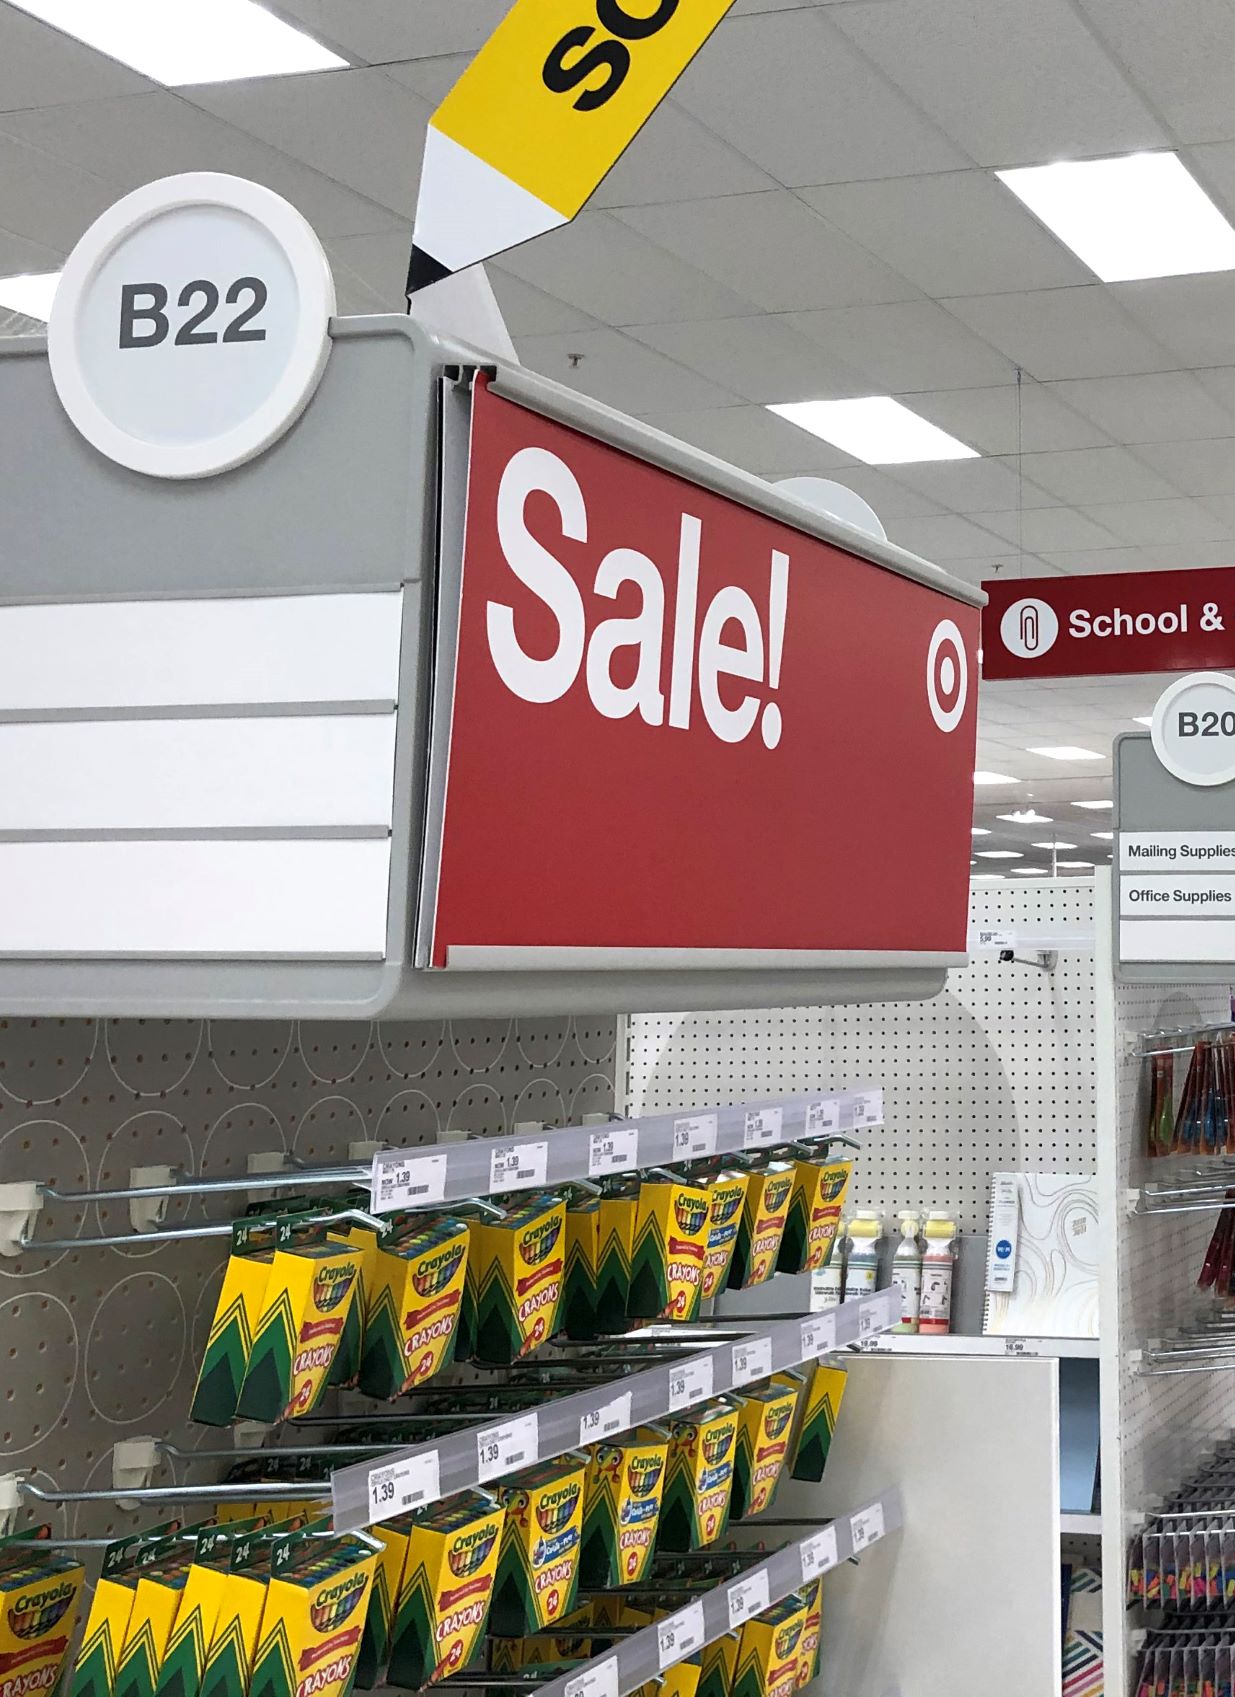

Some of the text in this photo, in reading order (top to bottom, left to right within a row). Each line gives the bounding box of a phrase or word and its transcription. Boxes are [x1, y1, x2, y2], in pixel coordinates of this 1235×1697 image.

[119, 276, 268, 349] B22
[486, 446, 790, 750] Sale!
[1069, 603, 1188, 639] School
[1200, 602, 1226, 632] &
[1128, 844, 1177, 860] Mailing
[1129, 889, 1232, 905] Office Supplies
[396, 1170, 410, 1184] 1.39
[678, 1192, 708, 1213] Crayola
[236, 1227, 248, 1246] 24
[280, 1223, 291, 1242] 24
[522, 1215, 560, 1244] Crayola
[417, 1244, 463, 1277] Crayola
[318, 1261, 356, 1284] Crayola
[667, 1262, 701, 1286] CRAYONS
[518, 1281, 559, 1322] CRAYONS
[404, 1314, 455, 1357] CRAYONS
[293, 1344, 335, 1375] CRAYONS
[420, 1355, 432, 1373] 24
[734, 1356, 747, 1371] 1.39
[300, 1385, 310, 1402] 24
[670, 1380, 685, 1396] 1.39
[583, 1411, 600, 1429] 1.39
[705, 1423, 734, 1441] Crayola
[480, 1444, 499, 1464] 1.39
[631, 1454, 662, 1470] Crayola
[372, 1481, 395, 1505] 1.39
[539, 1483, 578, 1511] Crayola
[699, 1490, 727, 1515] CRAYONS
[199, 1535, 216, 1555] 24
[453, 1523, 496, 1552] Crayola
[620, 1527, 651, 1550] CRAYONS
[107, 1546, 124, 1568] 24
[235, 1542, 250, 1563] 24
[277, 1543, 290, 1566] 24
[535, 1560, 573, 1594] CRAYONS
[15, 1582, 73, 1613] Crayola
[316, 1572, 367, 1608] Crayola
[548, 1595, 558, 1611] 24
[436, 1600, 485, 1642] CRAYONS
[449, 1643, 462, 1662] 24
[660, 1633, 675, 1653] 1.39
